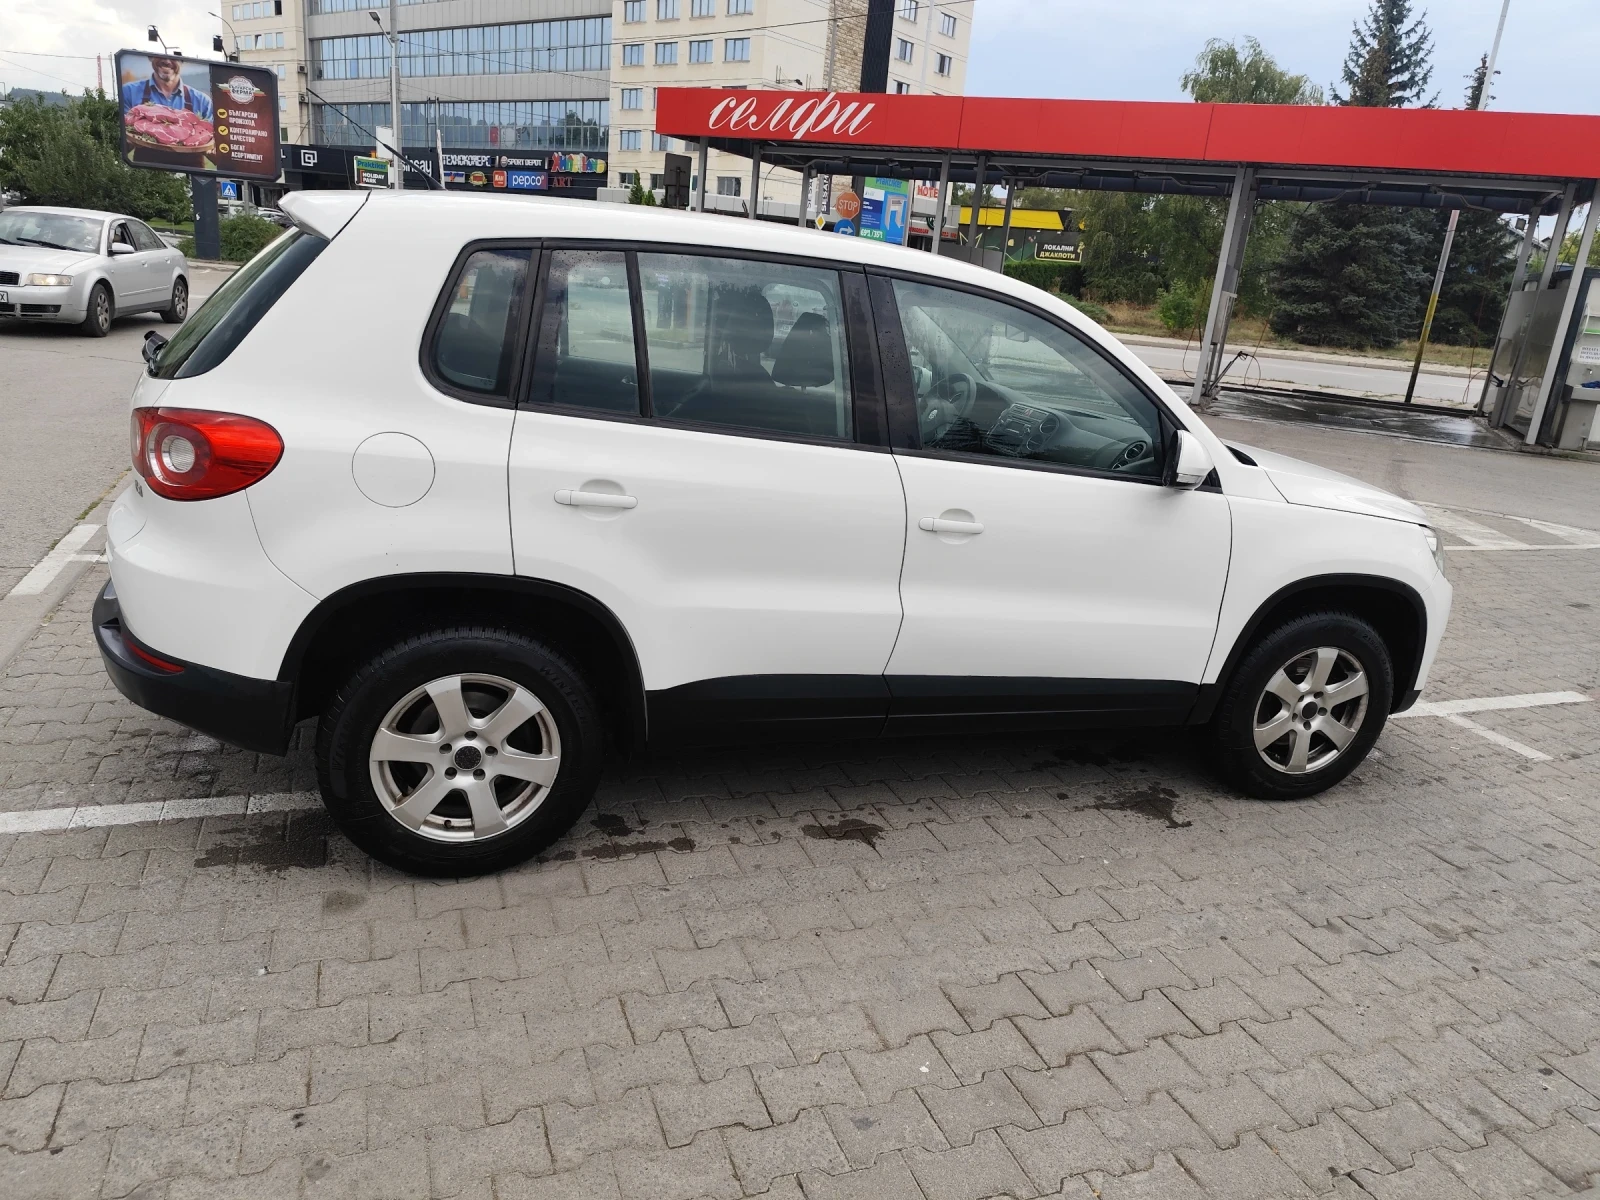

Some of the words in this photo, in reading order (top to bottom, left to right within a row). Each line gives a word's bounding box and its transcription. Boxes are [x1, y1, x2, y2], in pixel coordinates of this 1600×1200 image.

[228, 109, 258, 119] БЪЛГАРСКИ
[709, 92, 876, 139] селфи
[230, 134, 256, 143] КАЧЕСТВО
[230, 143, 246, 151] БОГАТ
[231, 151, 263, 161] АСОРТИМЕНТ
[357, 160, 387, 170] Praktiker
[507, 158, 525, 166] SPORT
[524, 159, 543, 167] DEPOT
[362, 172, 385, 180] HOLIDAY
[512, 174, 542, 188] pepco
[552, 176, 573, 188] ART
[917, 185, 939, 198] HOTE
[838, 200, 858, 211] STOP
[1042, 244, 1075, 252] ЛОКАЛНИ
[1039, 251, 1076, 260] ДЖАКПОТИ
